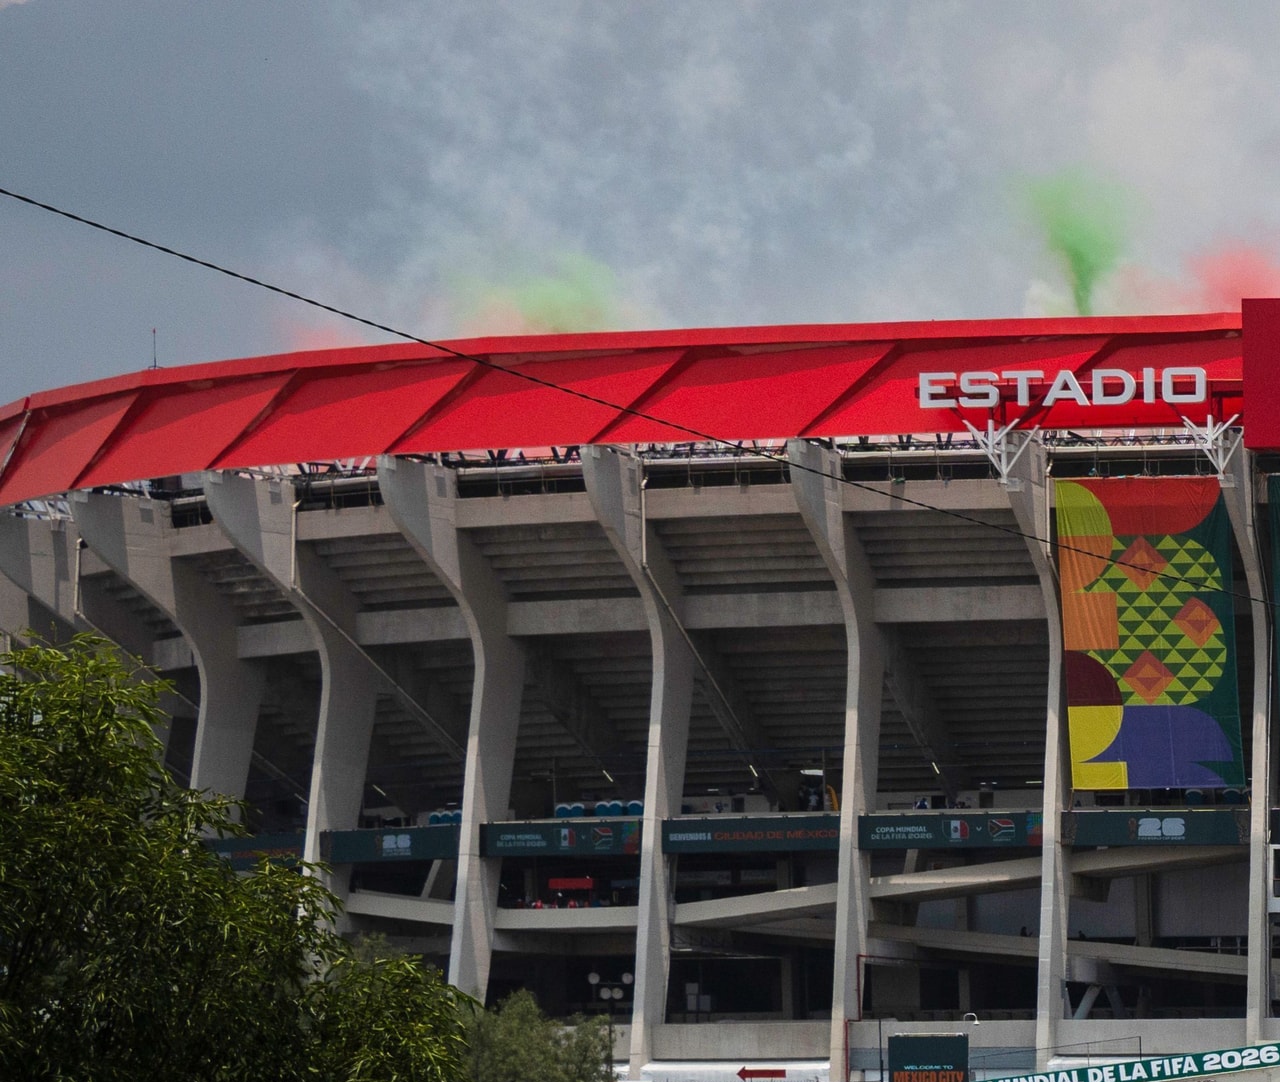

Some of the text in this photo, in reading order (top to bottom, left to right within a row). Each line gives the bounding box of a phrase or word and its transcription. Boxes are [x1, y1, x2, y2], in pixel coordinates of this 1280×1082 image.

[919, 366, 1208, 409] ESTADIO
[1119, 1063, 1149, 1082] LA
[1150, 1055, 1199, 1078] FIFA
[1202, 1046, 1280, 1071] 2026
